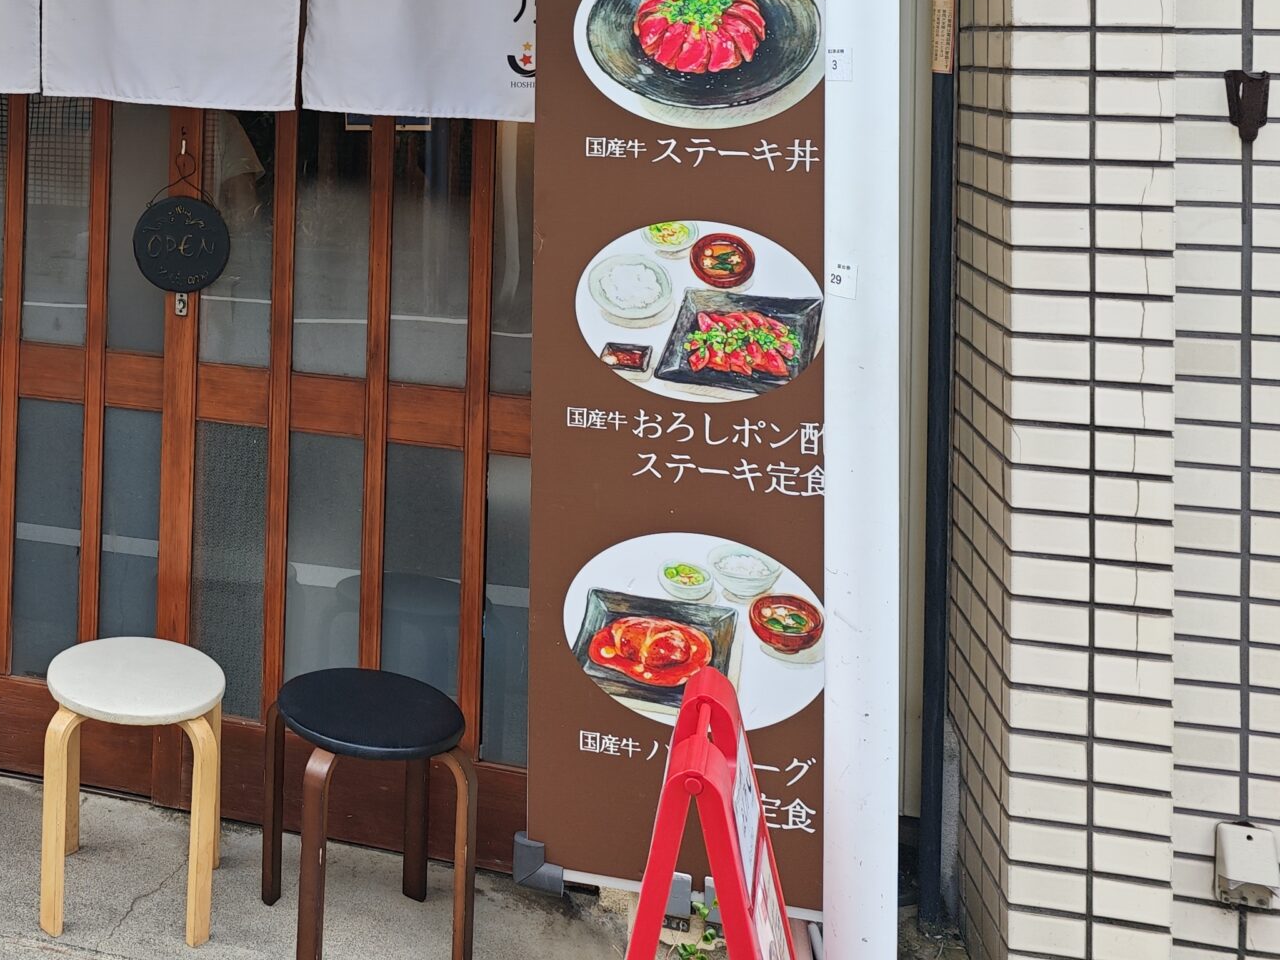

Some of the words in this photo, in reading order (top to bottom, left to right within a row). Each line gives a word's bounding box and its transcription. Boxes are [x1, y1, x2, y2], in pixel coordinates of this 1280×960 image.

[832, 60, 838, 71] 3
[585, 136, 647, 160] 国産牛
[651, 138, 820, 173] ステーキ丼
[146, 234, 215, 258] OPEN
[830, 273, 842, 285] 29
[566, 406, 628, 431] 国産牛
[631, 408, 824, 456] おろしポン酢
[631, 450, 824, 496] ステーキ定食
[579, 730, 641, 759] 国産牛
[761, 792, 817, 834] 定食
